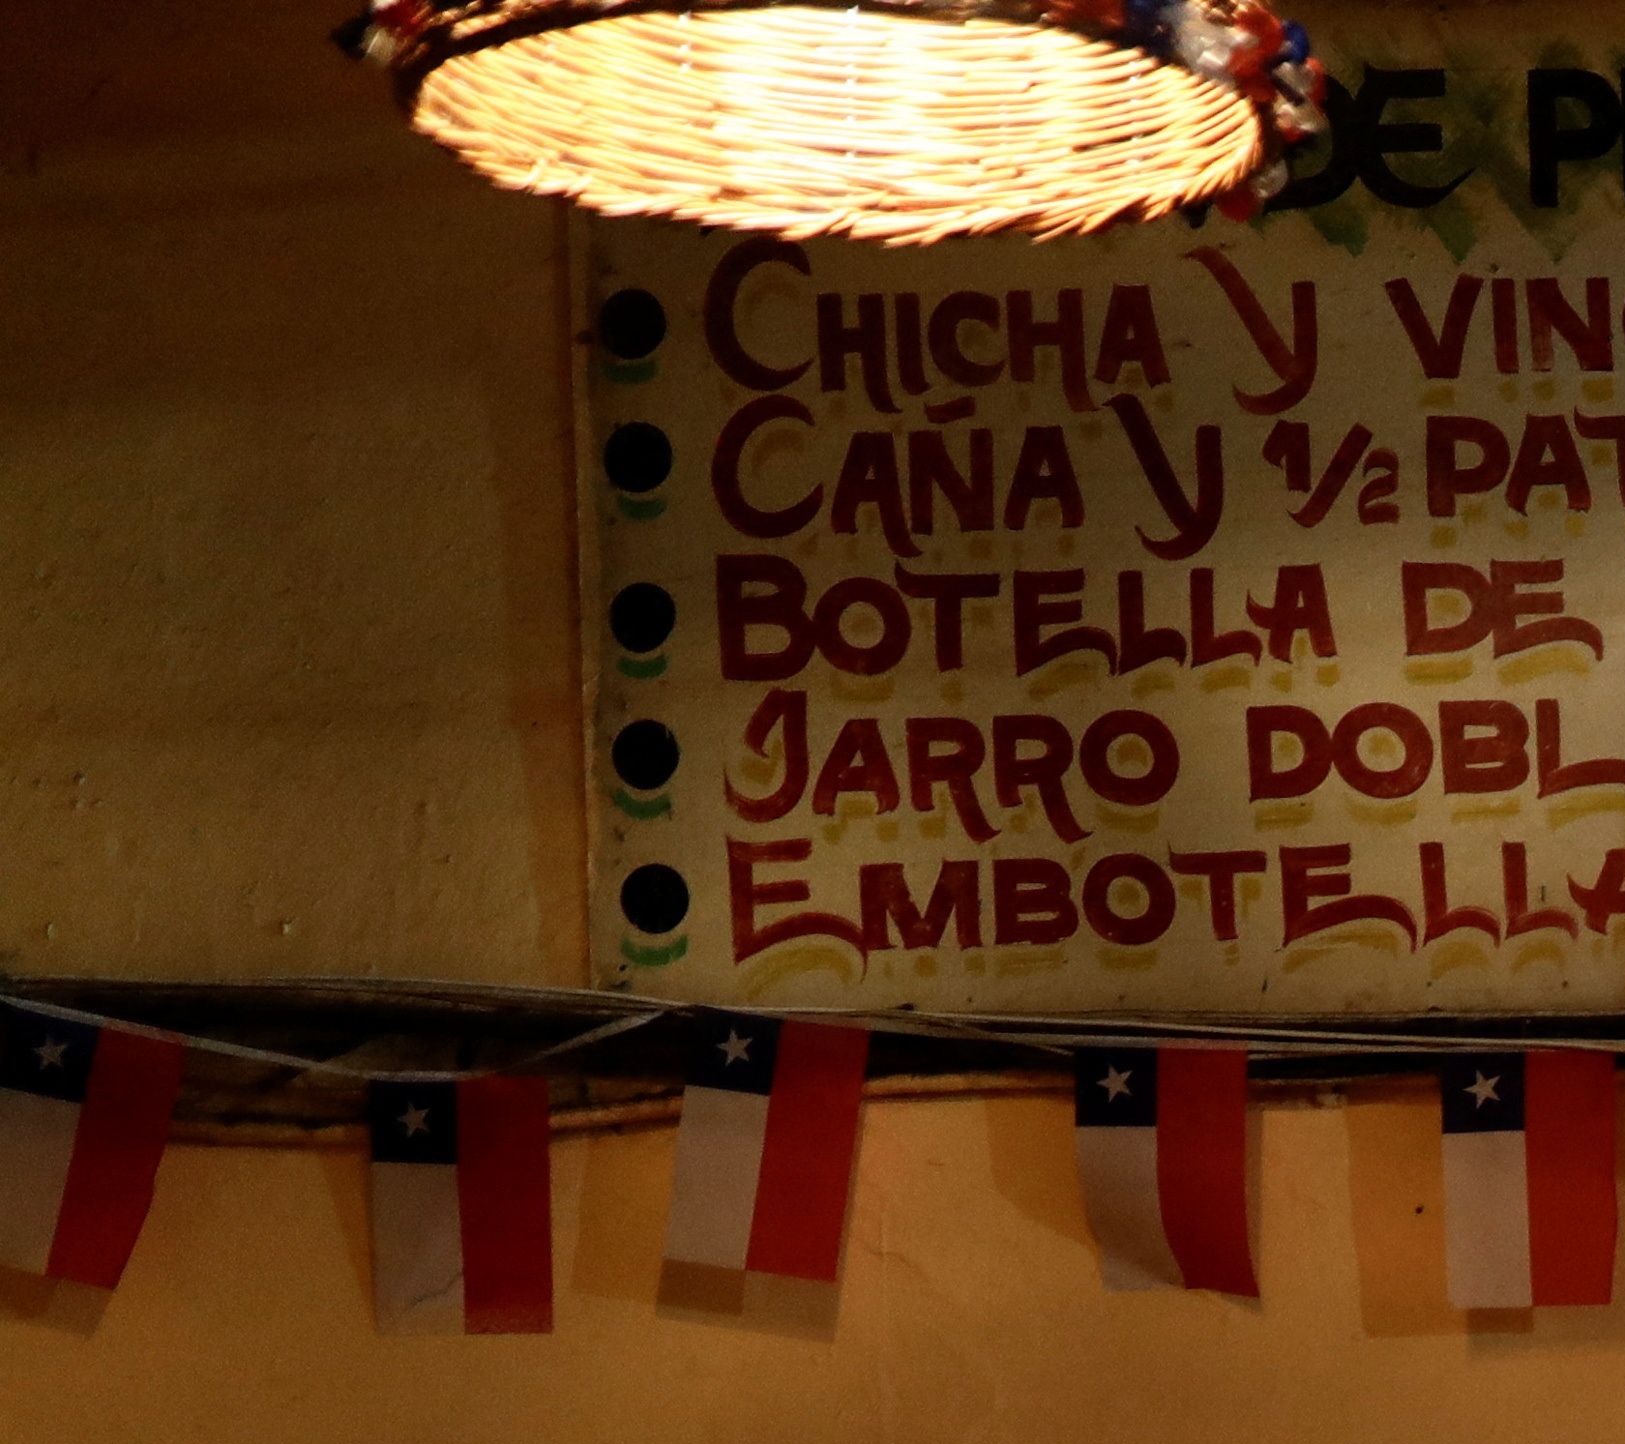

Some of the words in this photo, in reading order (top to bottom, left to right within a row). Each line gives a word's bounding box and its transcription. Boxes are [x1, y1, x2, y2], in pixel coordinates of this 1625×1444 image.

[706, 237, 1171, 412] CHICHA
[1184, 251, 1318, 415] Y
[709, 393, 1085, 557] CAÑA
[1110, 393, 1225, 559] Y
[716, 556, 1338, 682] BOTELLA
[1402, 559, 1605, 661] DE
[722, 690, 1181, 842] JARRO
